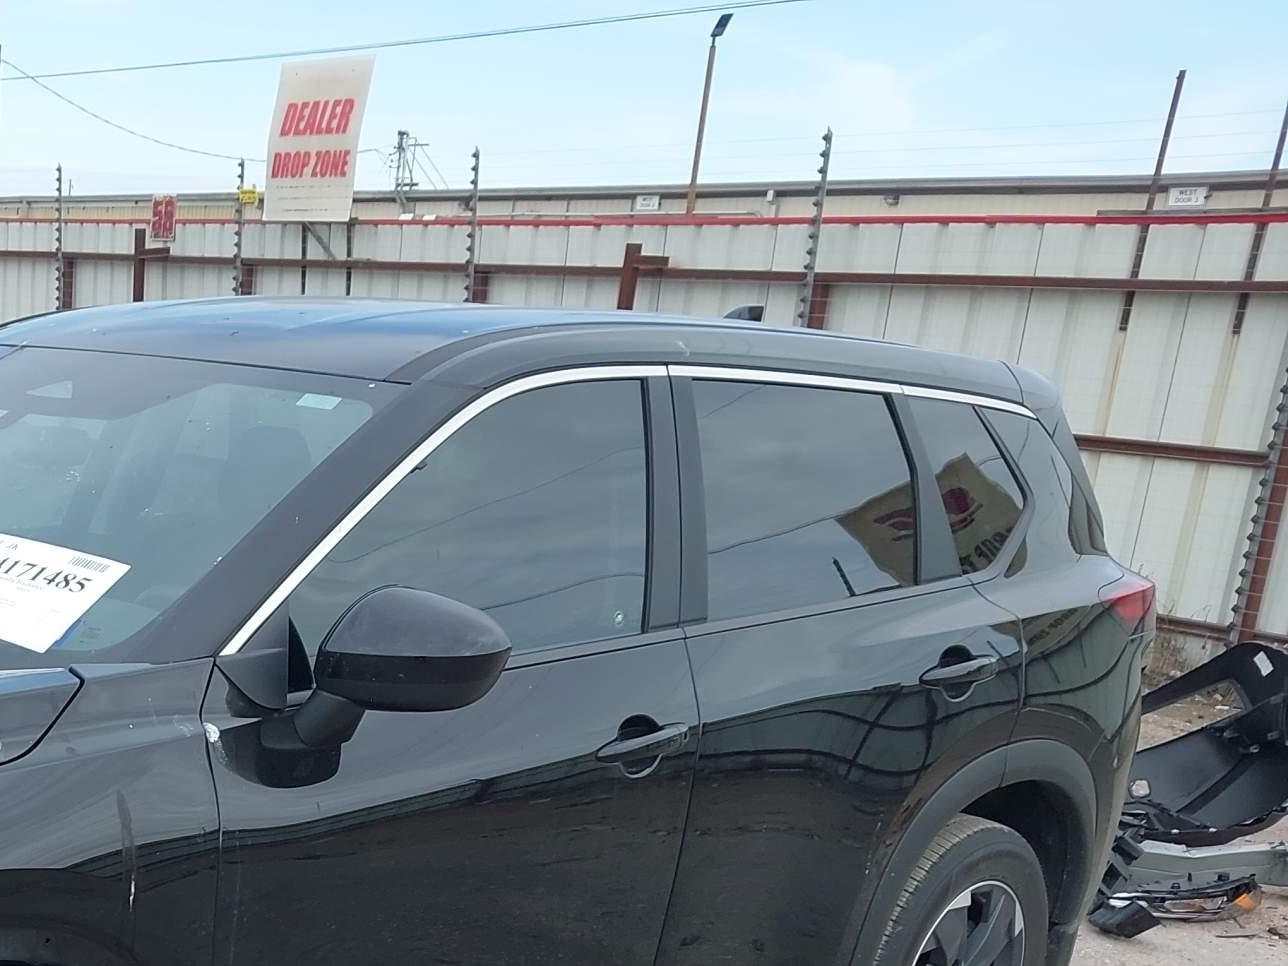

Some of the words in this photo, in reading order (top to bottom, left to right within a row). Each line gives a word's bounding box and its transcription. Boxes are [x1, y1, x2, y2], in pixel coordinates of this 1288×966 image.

[279, 98, 355, 137] DEALER
[271, 151, 311, 178] DROP
[311, 149, 351, 178] ZONE
